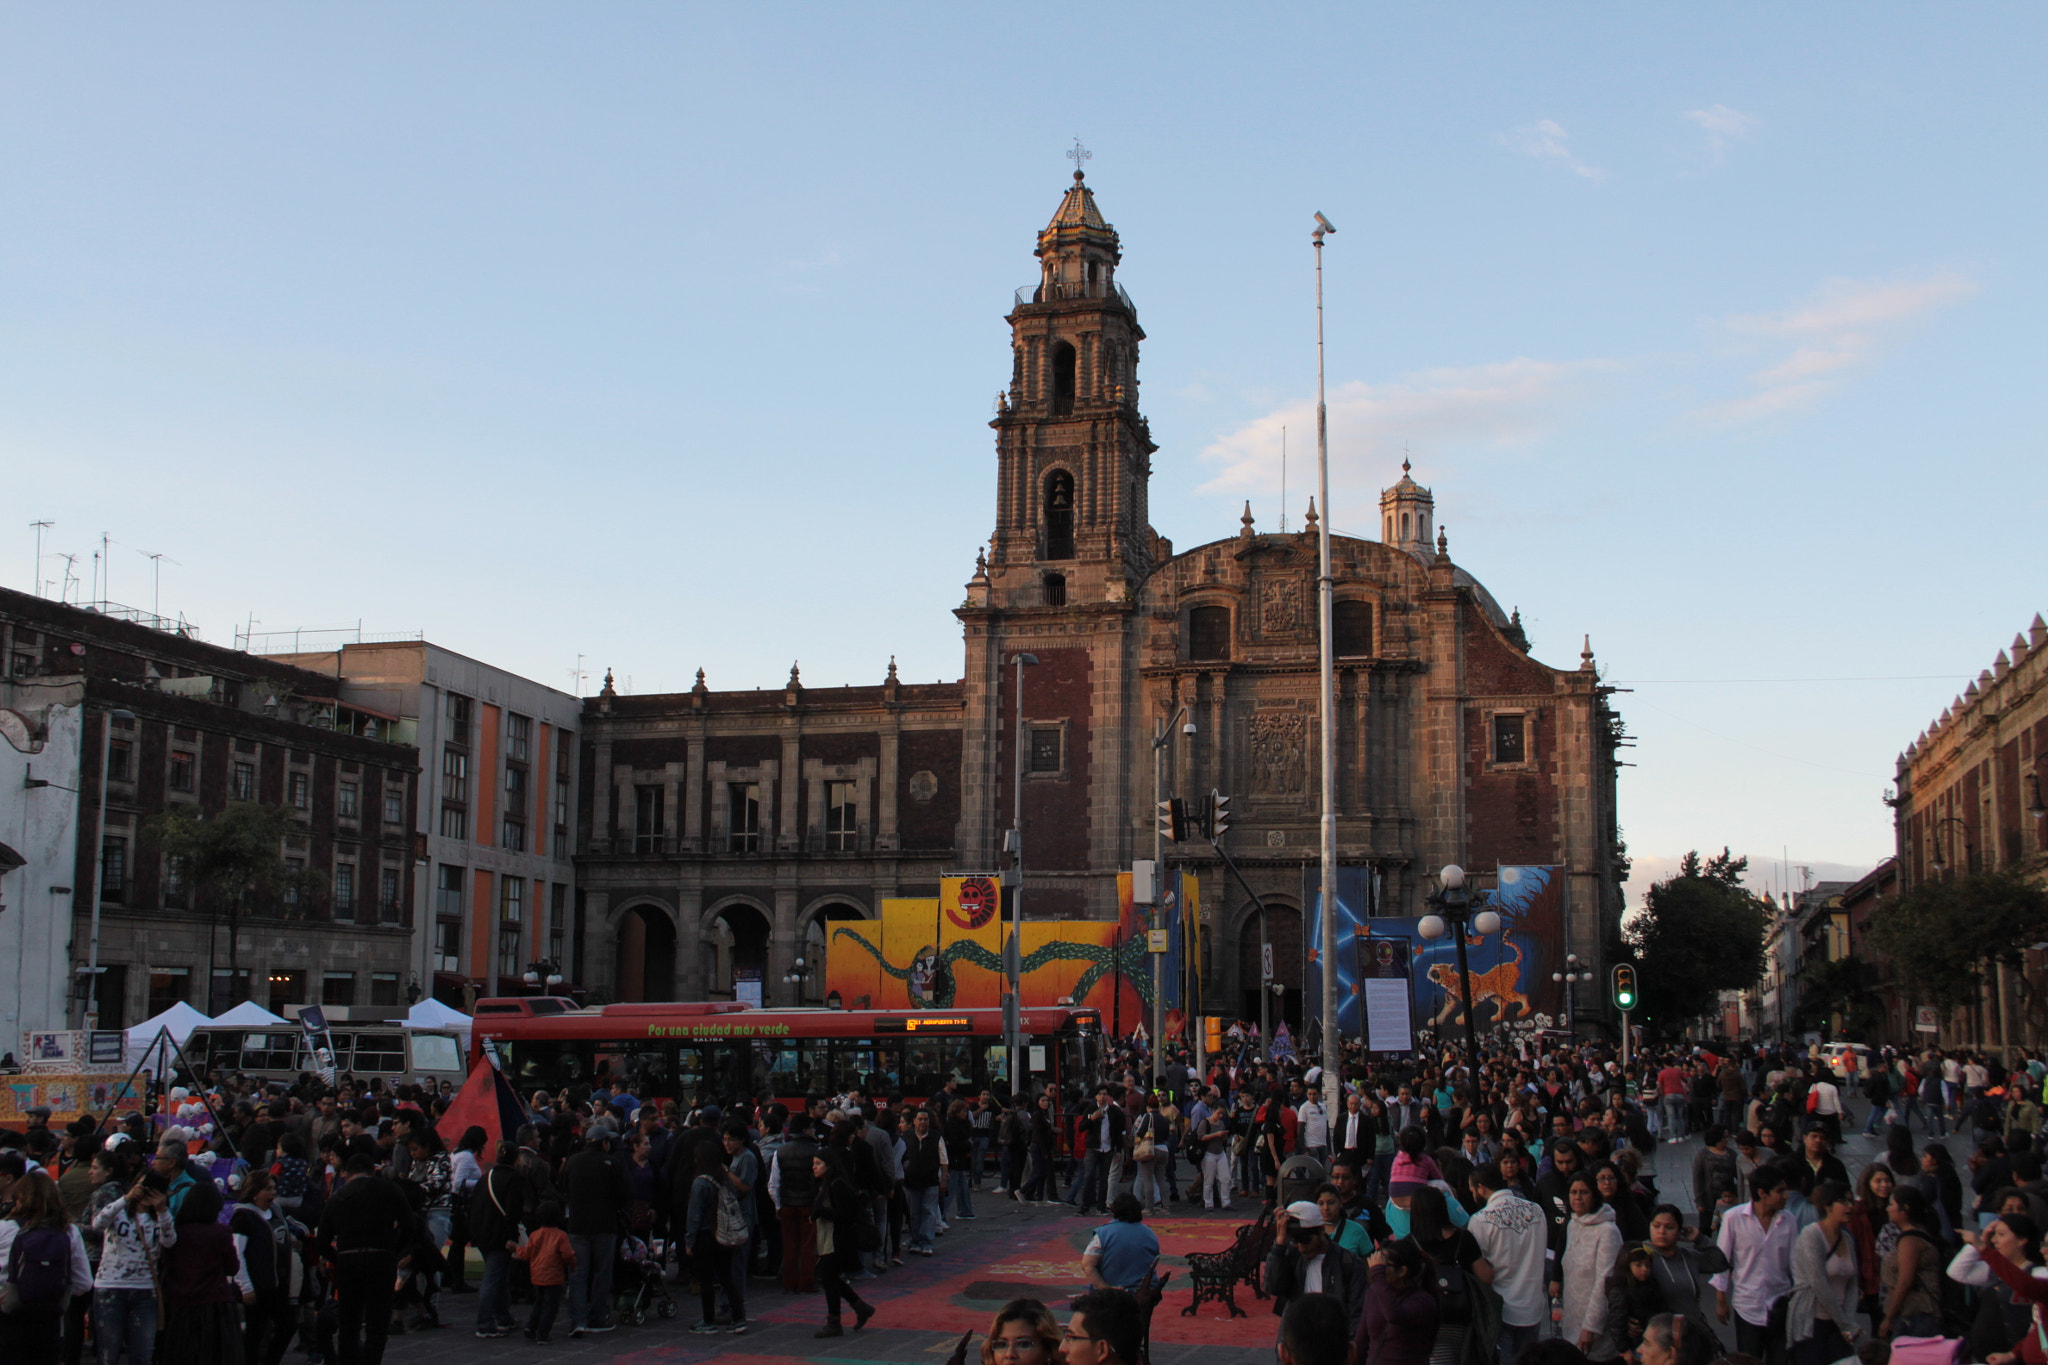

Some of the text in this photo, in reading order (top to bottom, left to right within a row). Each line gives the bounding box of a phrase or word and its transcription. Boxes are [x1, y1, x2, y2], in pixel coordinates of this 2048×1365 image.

[648, 1022, 790, 1036] Por una ciudad más verde
